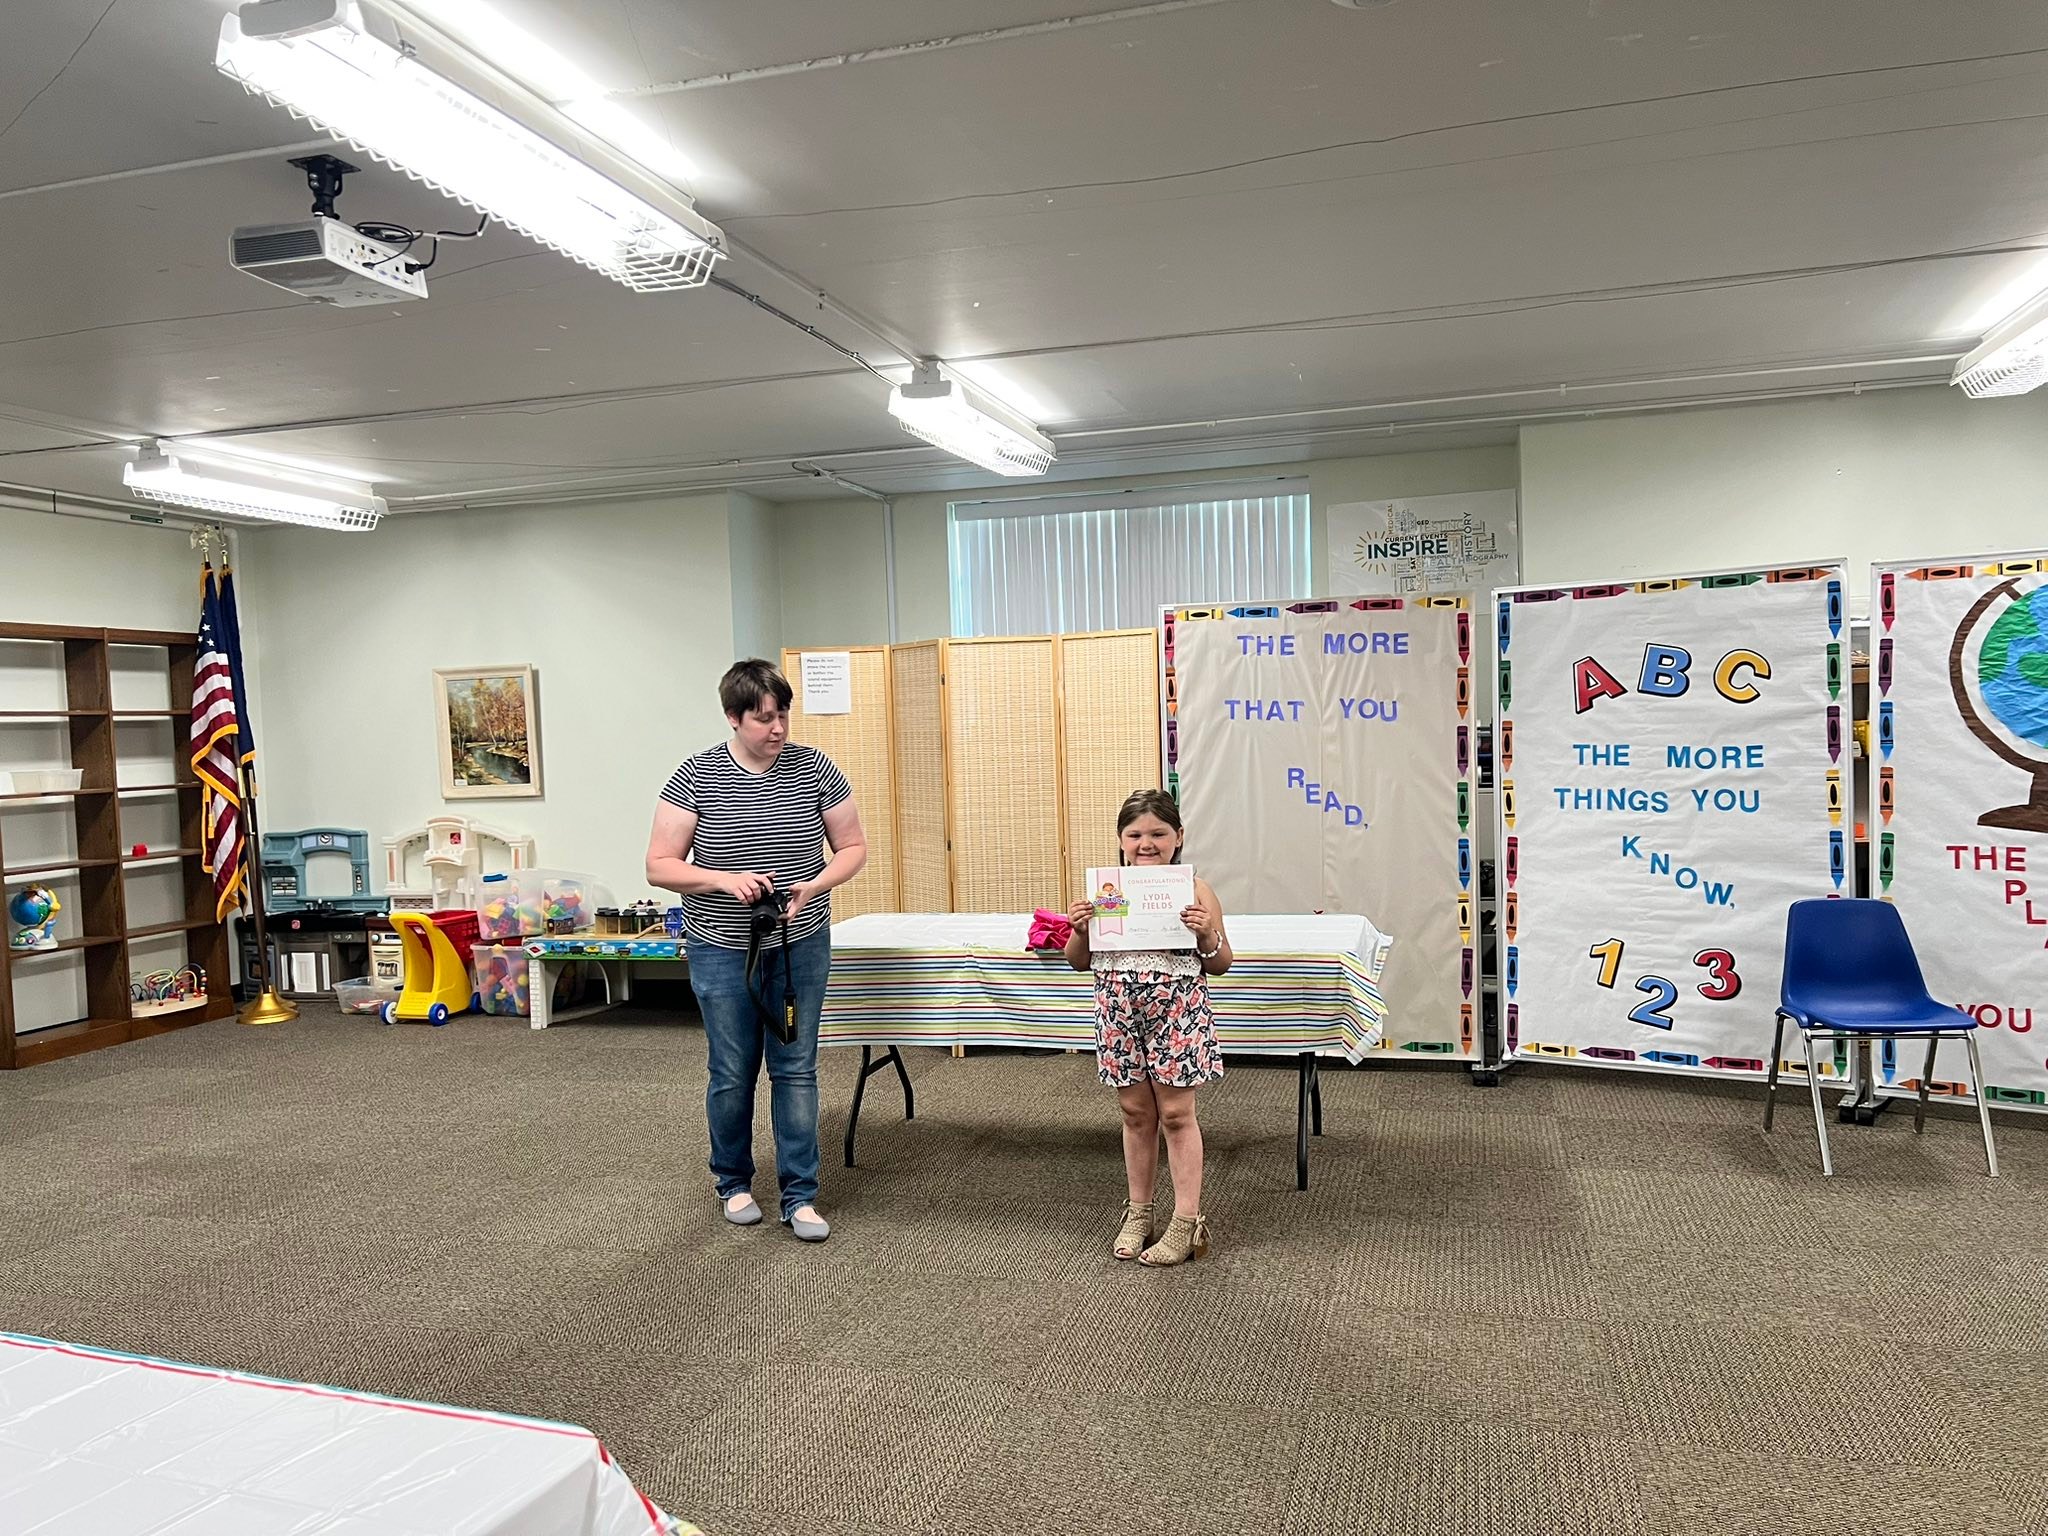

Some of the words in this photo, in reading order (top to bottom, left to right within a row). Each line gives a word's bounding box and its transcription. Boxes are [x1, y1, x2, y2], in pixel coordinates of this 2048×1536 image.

[1385, 534, 1419, 543] CURRENT
[1420, 532, 1449, 541] EVENTS
[1463, 511, 1473, 558] HISTORY
[1367, 538, 1449, 560] INSPIRE
[1236, 634, 1296, 656] THE
[1323, 632, 1409, 655] MORE
[1224, 699, 1305, 721] THAT
[1339, 698, 1398, 722] YOU
[1572, 743, 1631, 767] THE
[1667, 744, 1764, 769] MORE
[1554, 787, 1669, 813] THINGS
[1691, 788, 1760, 813] YOU
[1946, 845, 2027, 872] THE
[1142, 902, 1173, 910] FIELDS
[1143, 893, 1171, 901] LYDIA
[786, 1005, 794, 1027] Nikon
